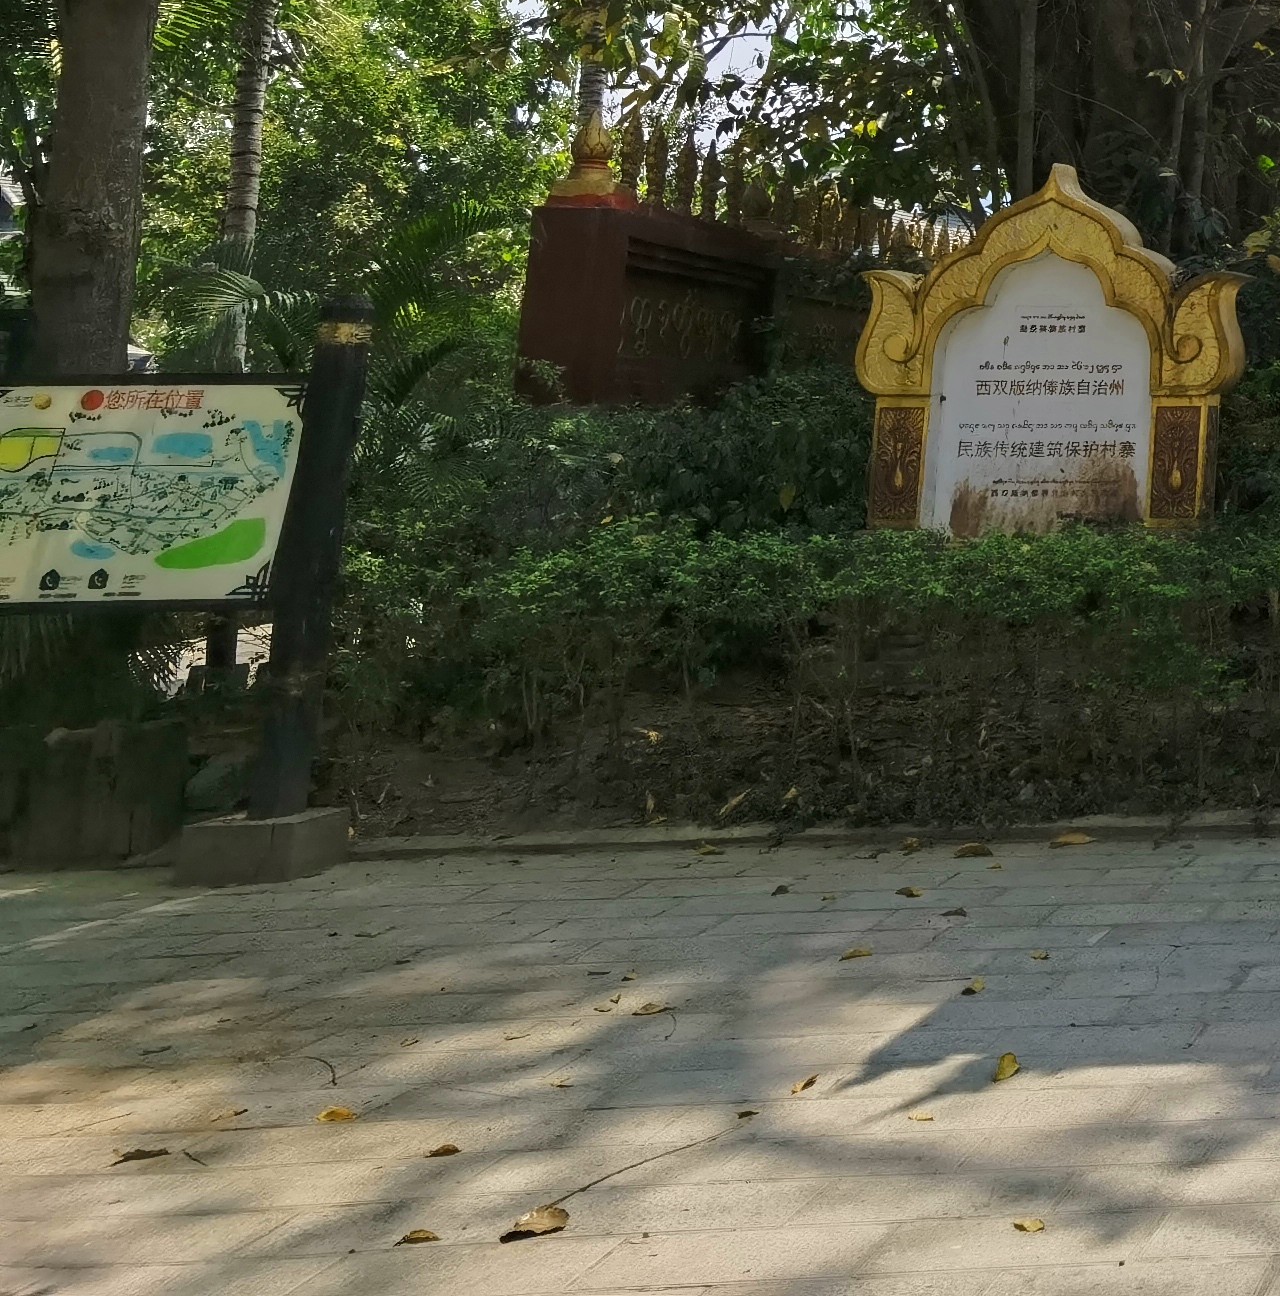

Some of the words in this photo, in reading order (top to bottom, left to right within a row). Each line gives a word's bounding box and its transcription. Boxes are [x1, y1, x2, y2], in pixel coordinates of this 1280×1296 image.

[975, 379, 1125, 396] 西双版纳傣族自治州
[104, 389, 205, 410] 您所在位置
[957, 440, 1137, 458] 民族传统建筑保护村寨
